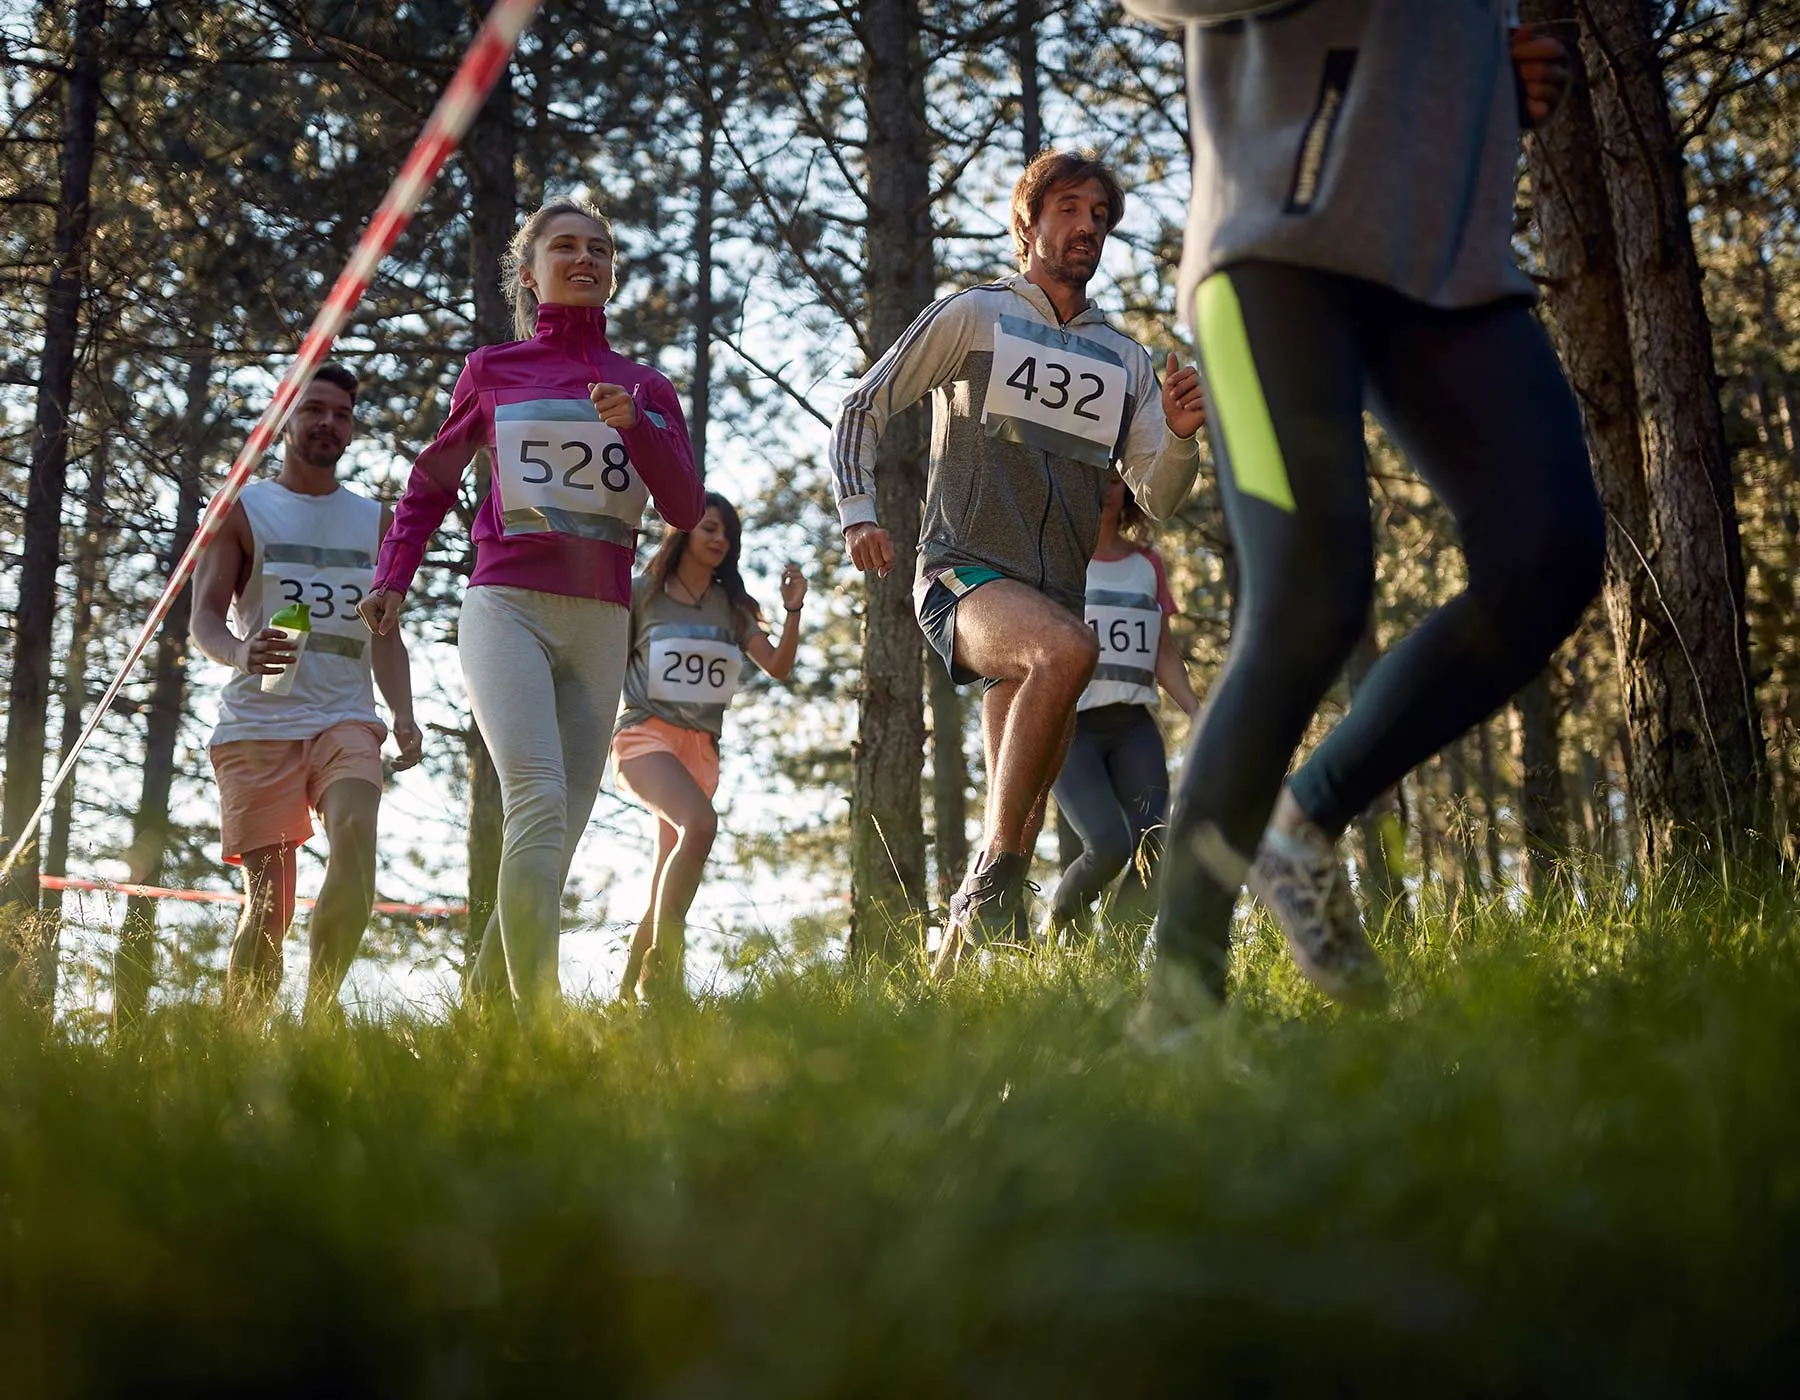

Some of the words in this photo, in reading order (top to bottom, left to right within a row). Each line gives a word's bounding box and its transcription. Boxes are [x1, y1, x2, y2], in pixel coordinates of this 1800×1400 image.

[1006, 356, 1104, 421] 432
[520, 440, 630, 492] 528
[280, 579, 363, 620] 333
[663, 651, 727, 688] 296
